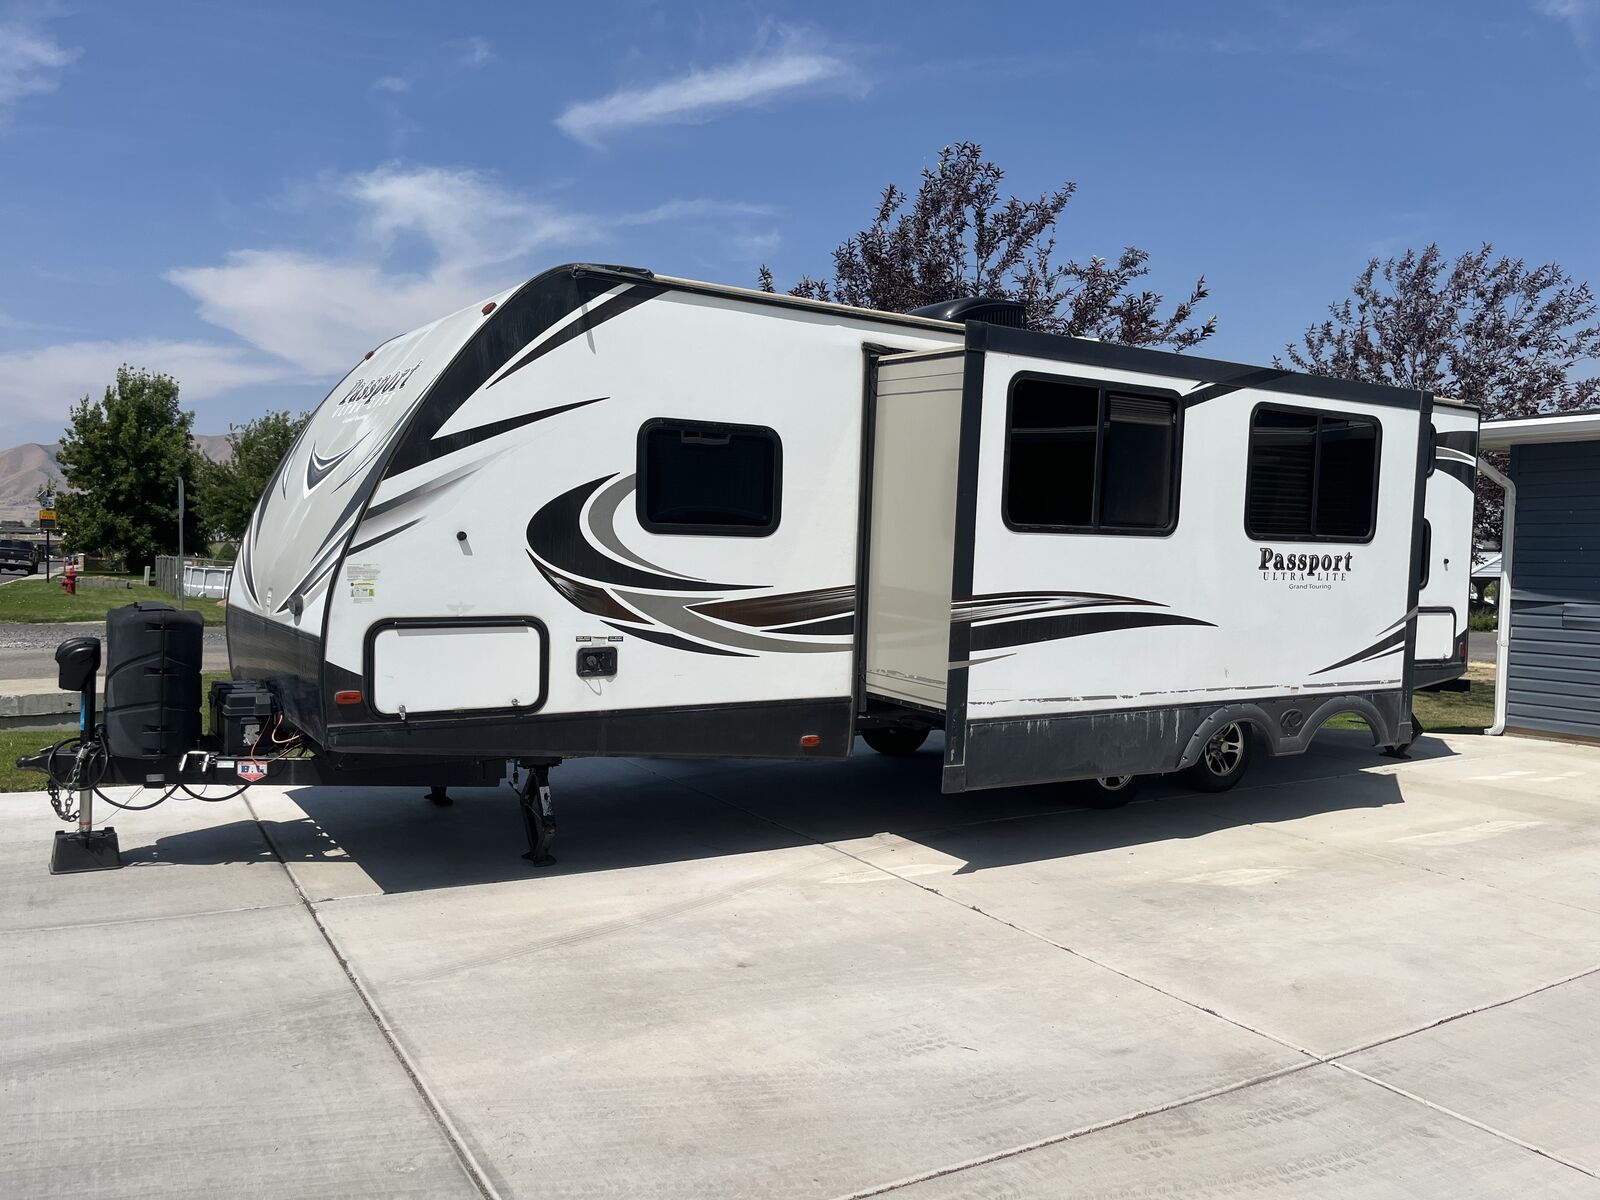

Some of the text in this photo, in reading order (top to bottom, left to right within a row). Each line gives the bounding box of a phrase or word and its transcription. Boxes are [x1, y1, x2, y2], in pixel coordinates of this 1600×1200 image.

[338, 359, 423, 405] Passport
[1258, 547, 1353, 576] Passport
[1263, 572, 1347, 581] ULTRA LITE
